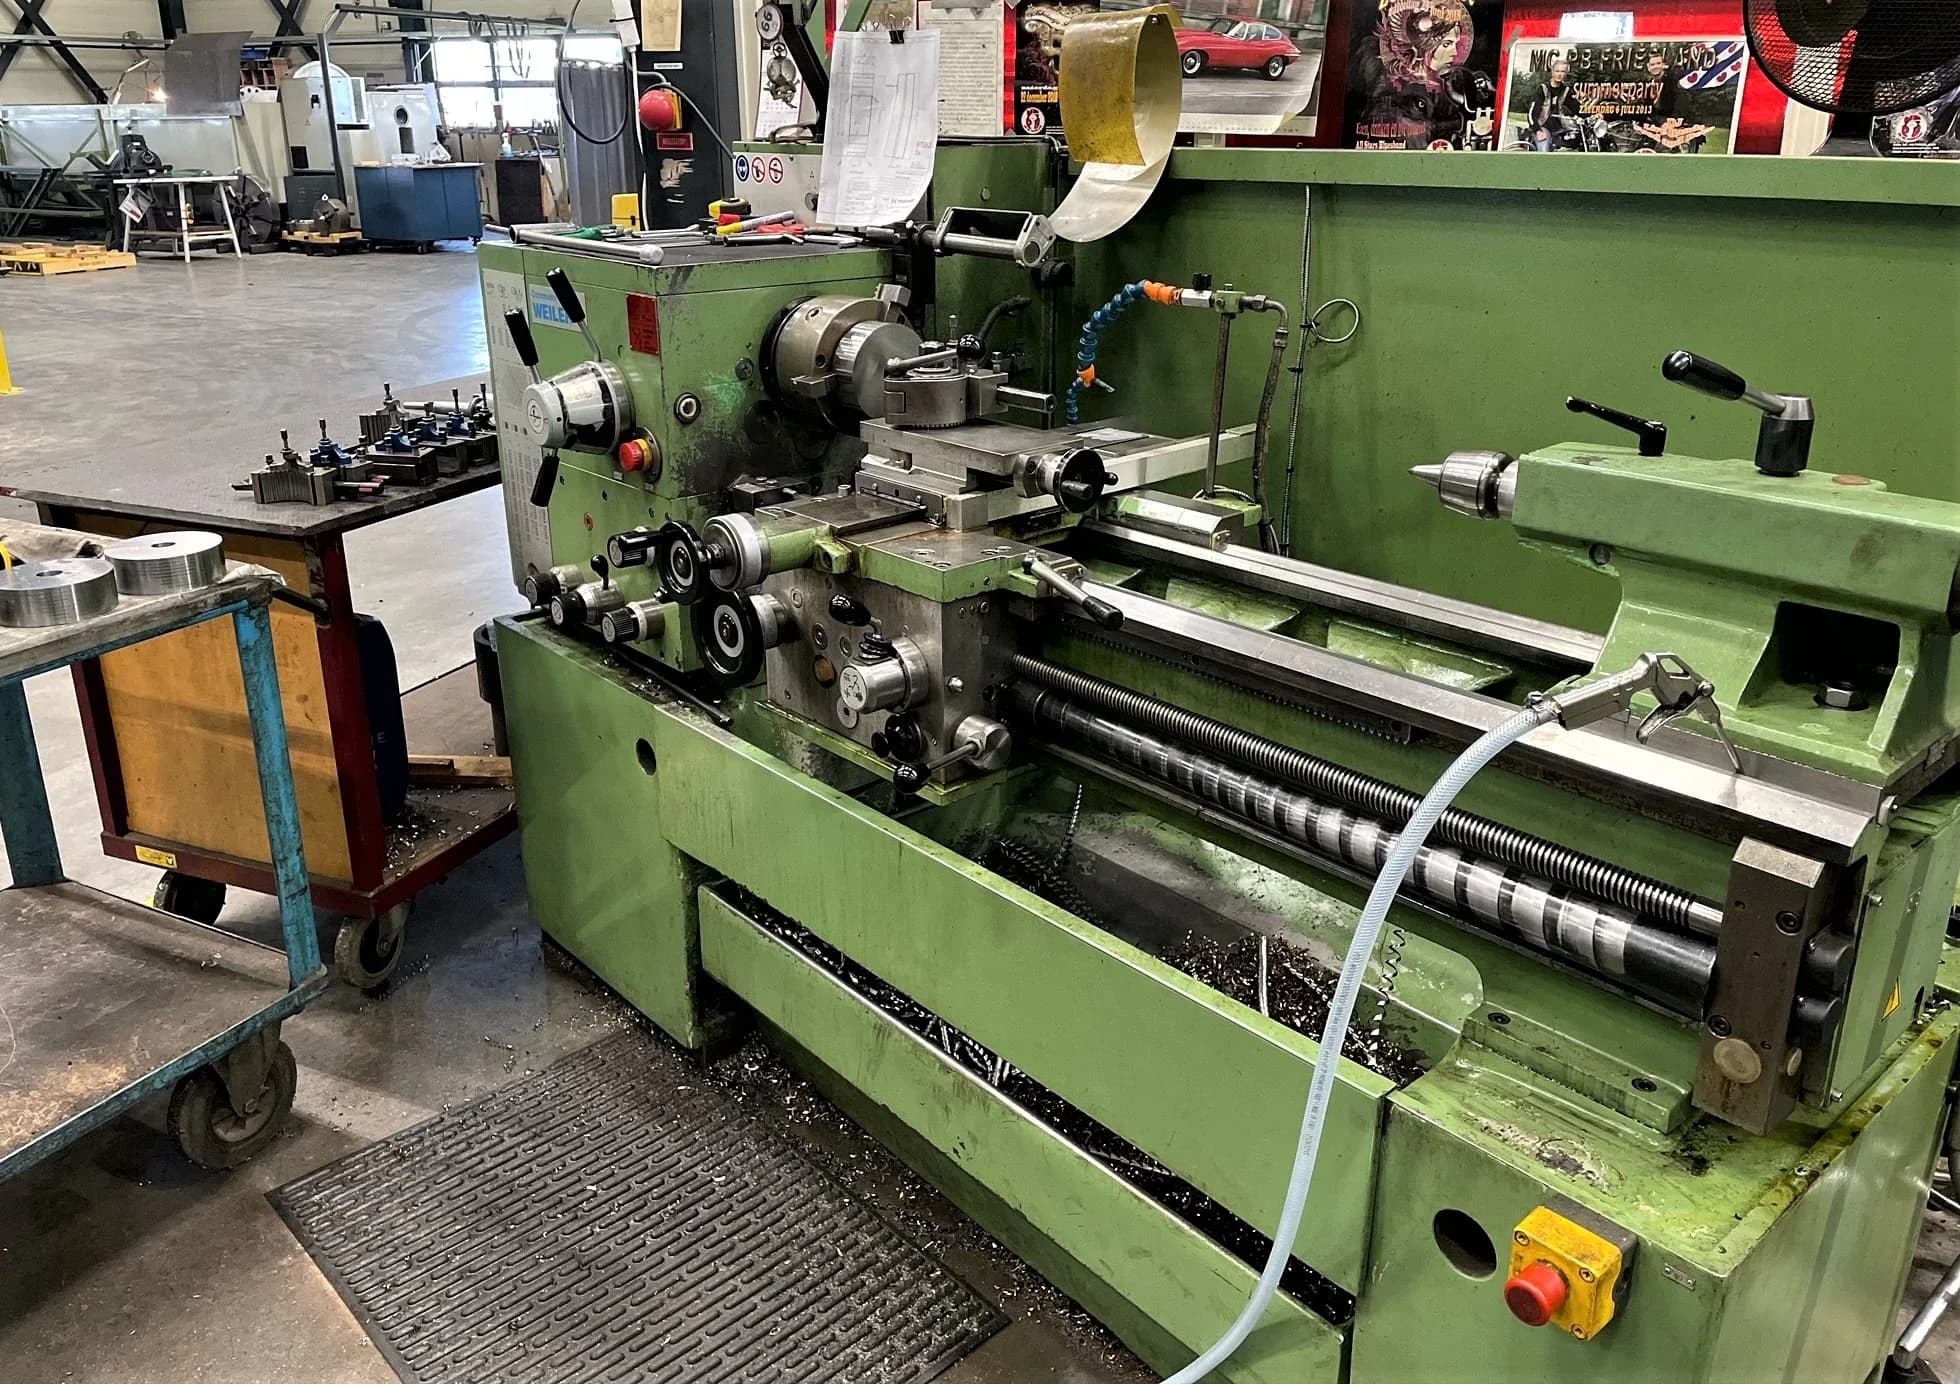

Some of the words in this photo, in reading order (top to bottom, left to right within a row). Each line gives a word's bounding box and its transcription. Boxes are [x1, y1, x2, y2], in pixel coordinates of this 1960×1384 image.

[1529, 49, 1560, 72] MC
[1566, 48, 1592, 72] PB
[1572, 79, 1664, 104] summerparty
[532, 302, 572, 325] WEILE
